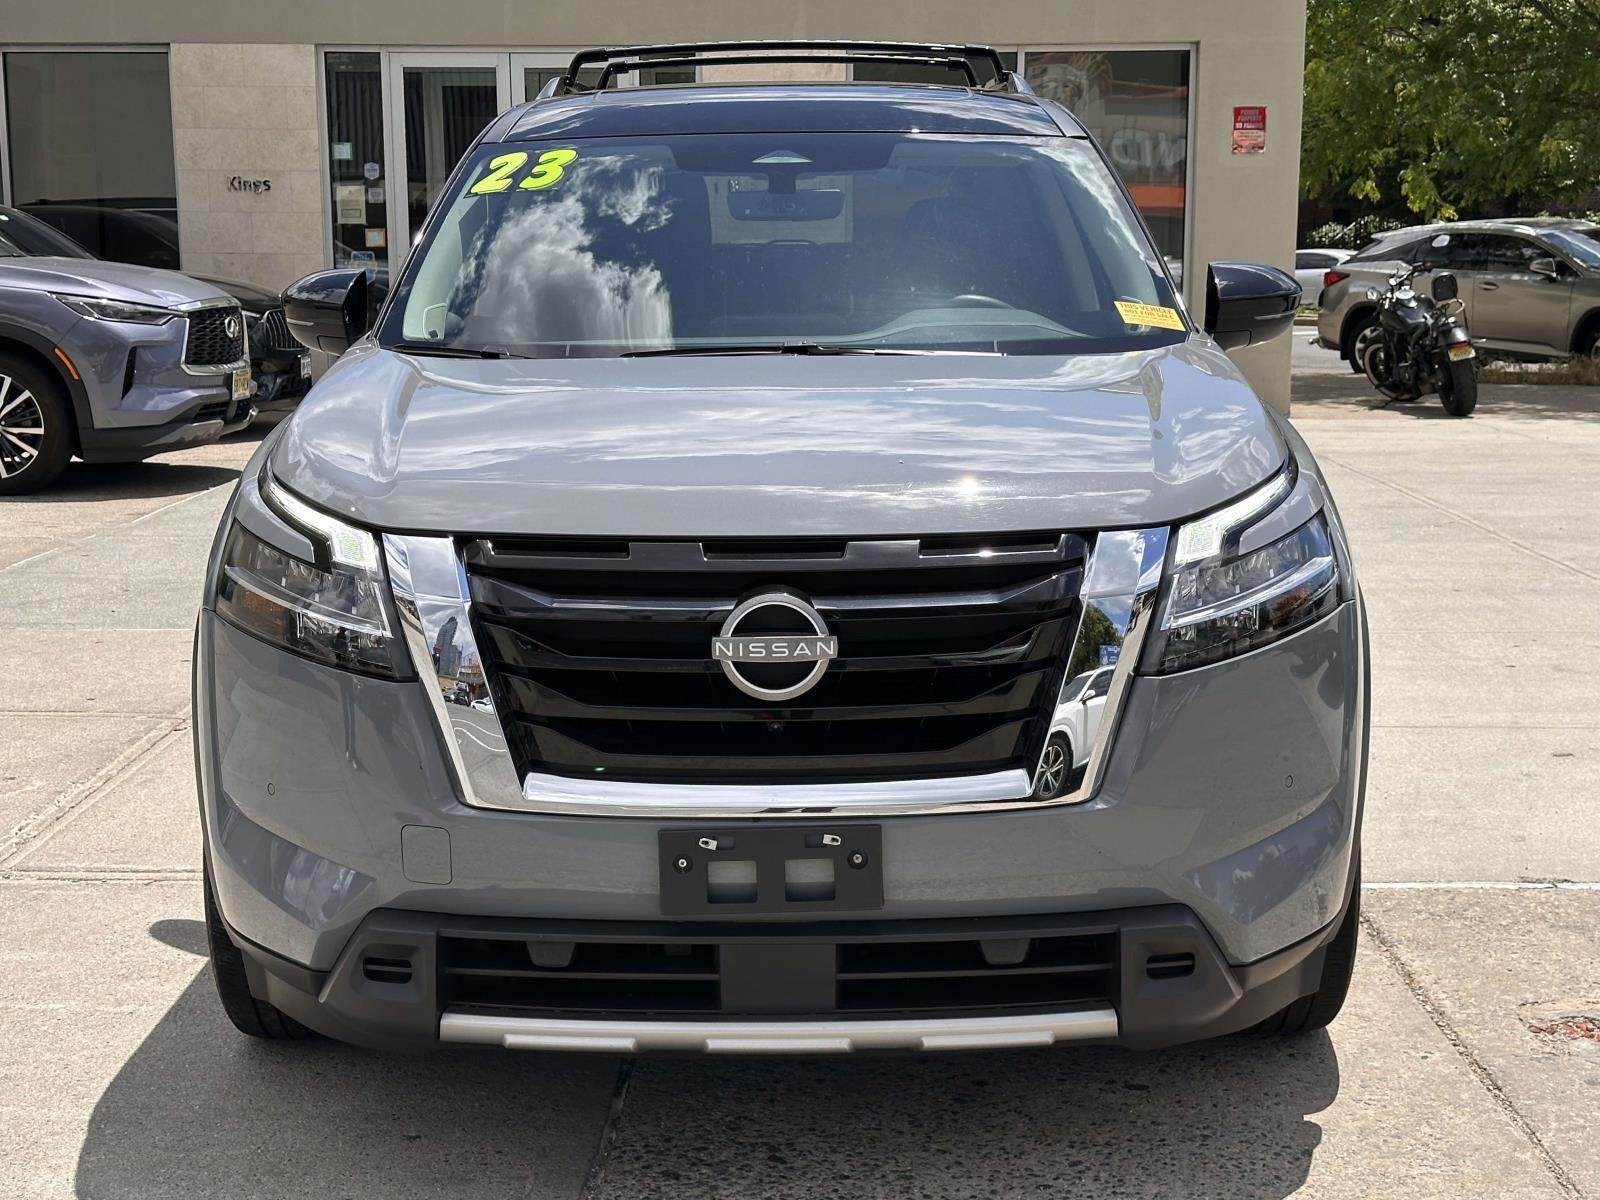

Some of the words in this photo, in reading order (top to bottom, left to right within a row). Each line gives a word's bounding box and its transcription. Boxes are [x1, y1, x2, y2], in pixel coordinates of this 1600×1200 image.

[467, 149, 579, 195] 23
[226, 175, 272, 195] Kings
[1119, 302, 1139, 310] THIS
[1139, 304, 1174, 315] VEHICLE
[1156, 312, 1175, 320] SALE
[715, 641, 834, 657] NISSAN
